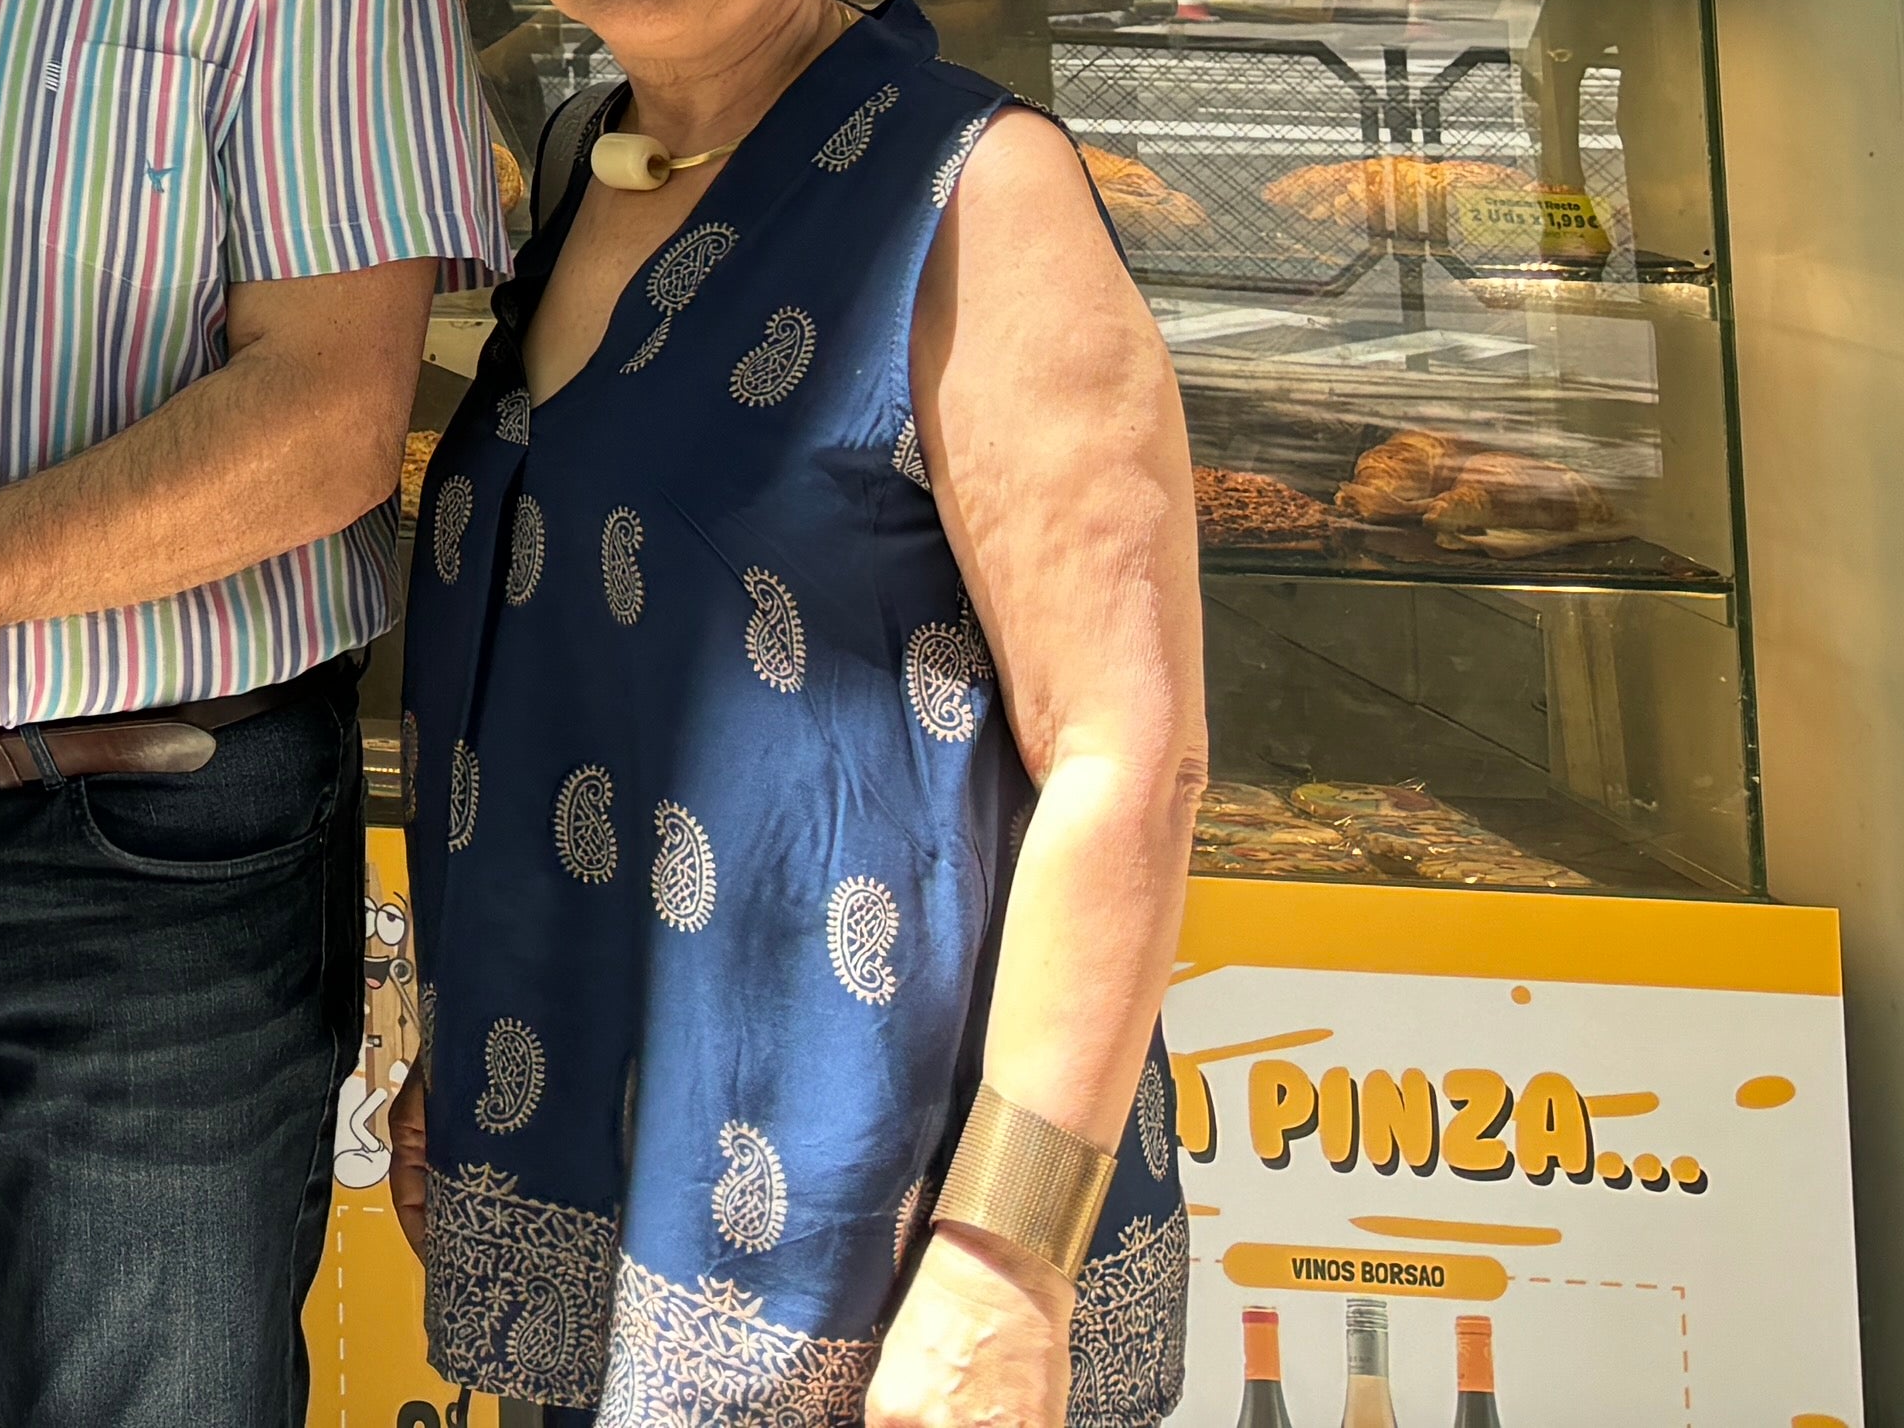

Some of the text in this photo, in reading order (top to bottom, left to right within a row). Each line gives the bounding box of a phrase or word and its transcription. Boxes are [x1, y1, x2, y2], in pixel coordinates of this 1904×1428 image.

[1544, 200, 1581, 212] Recto
[1292, 1257, 1445, 1288] VINOS BORSAO
